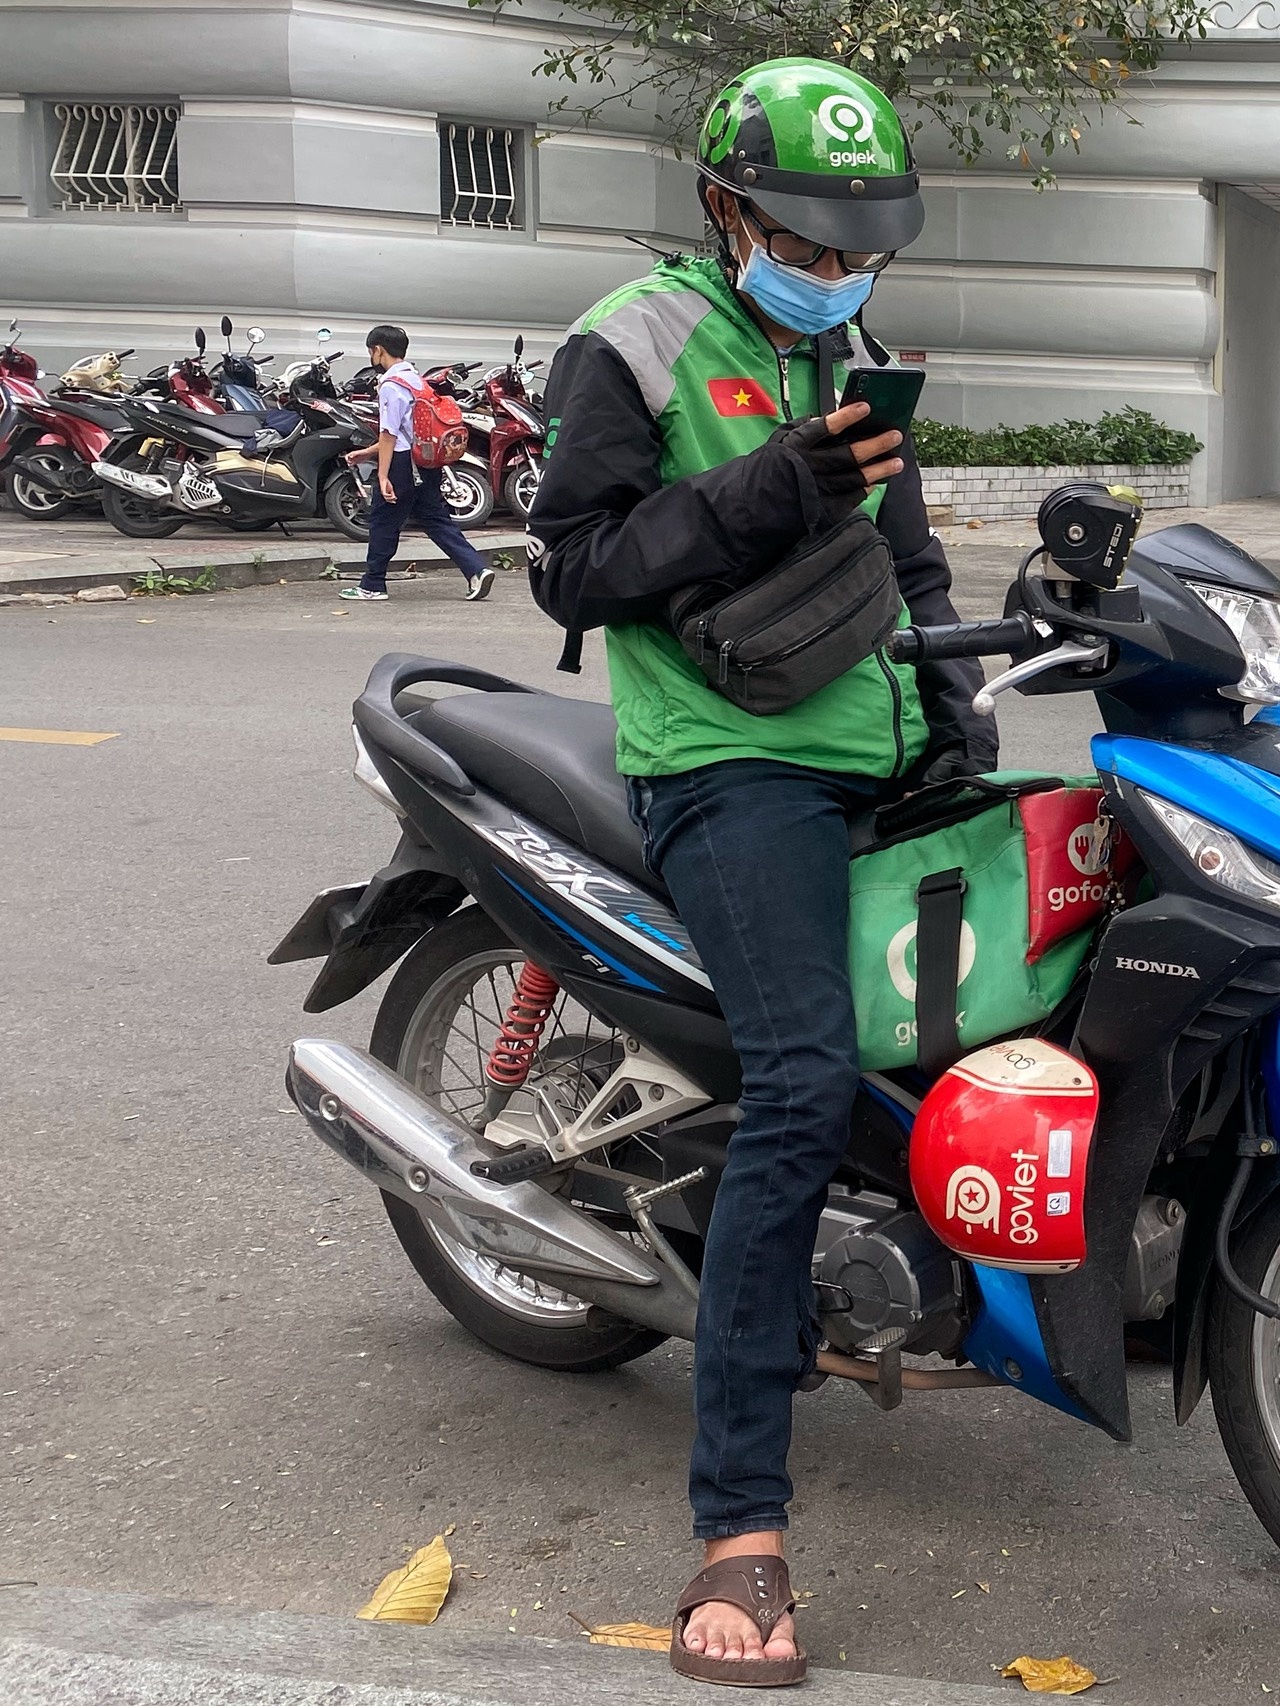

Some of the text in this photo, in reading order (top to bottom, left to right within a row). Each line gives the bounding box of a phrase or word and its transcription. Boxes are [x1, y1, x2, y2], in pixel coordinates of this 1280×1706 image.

[829, 150, 877, 167] gojek
[1103, 523, 1124, 568] STEDI
[1047, 880, 1104, 912] gofo
[1115, 956, 1201, 980] HONDA
[1006, 1149, 1040, 1245] goviet
